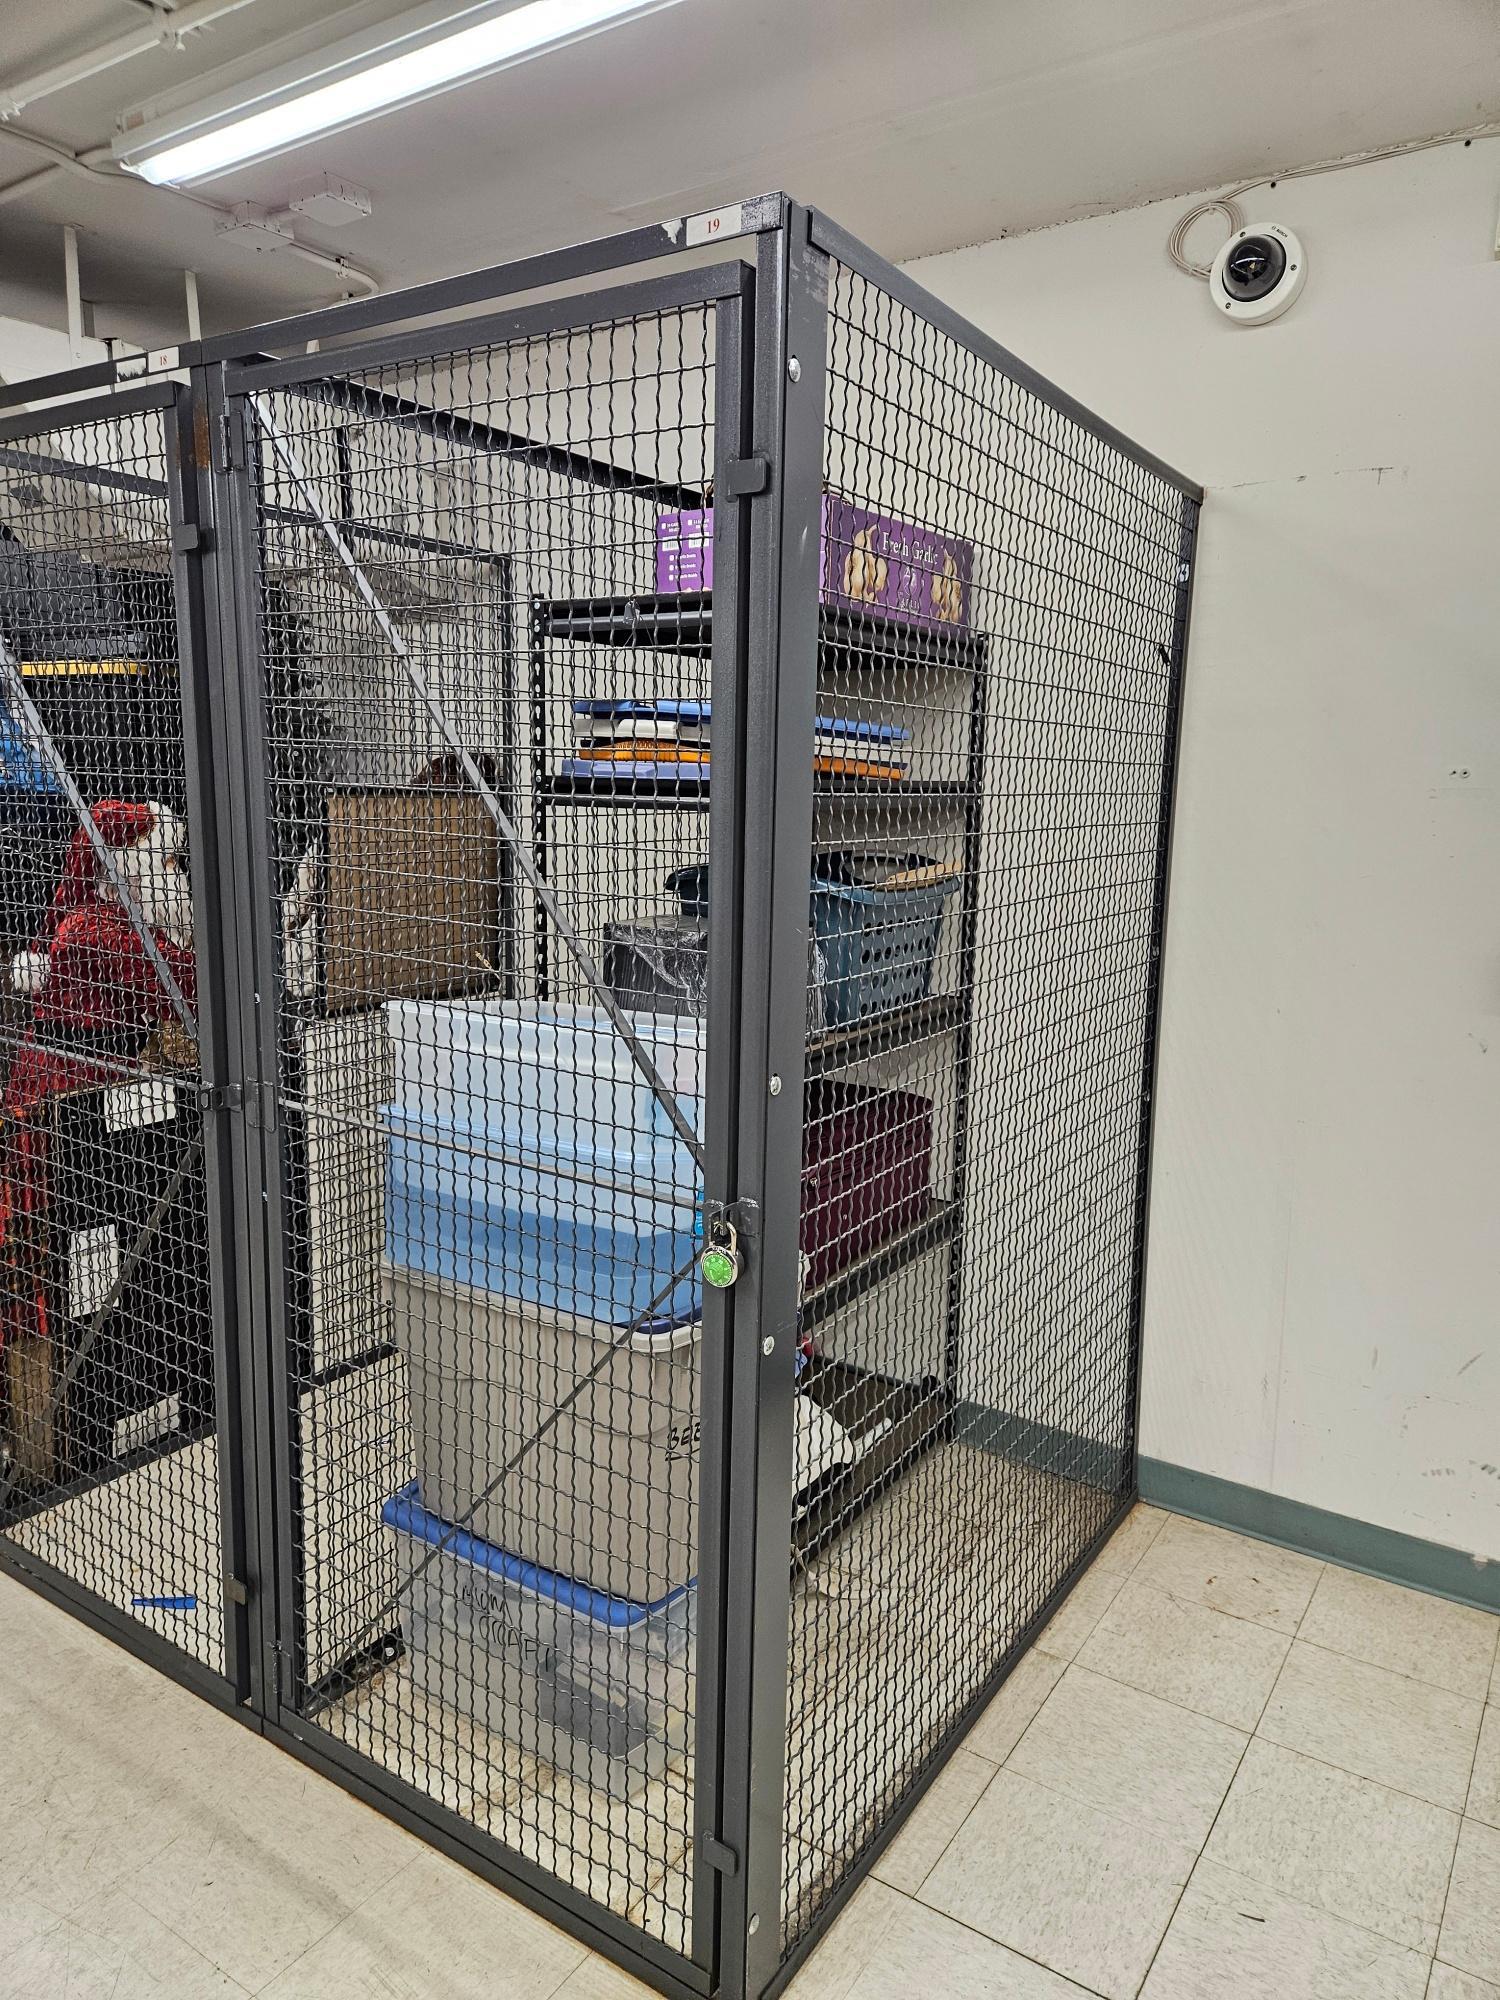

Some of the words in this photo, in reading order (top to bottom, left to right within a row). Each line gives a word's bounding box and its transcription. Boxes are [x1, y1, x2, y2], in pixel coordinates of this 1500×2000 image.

[706, 217, 720, 234] 19
[160, 354, 168, 366] 18
[911, 540, 939, 565] Garlic
